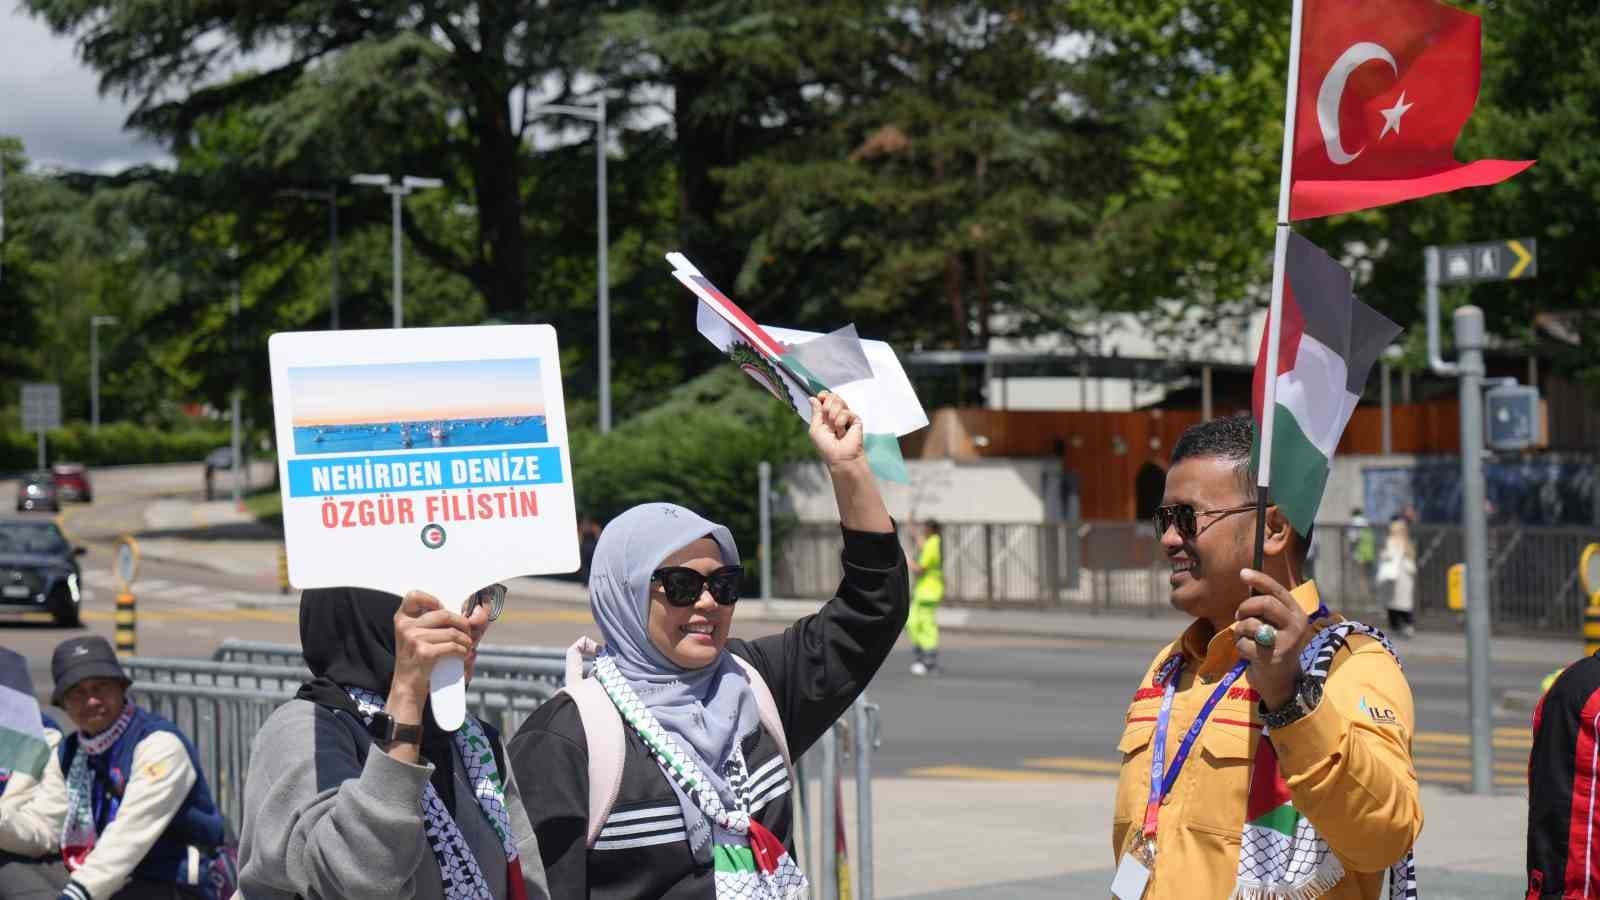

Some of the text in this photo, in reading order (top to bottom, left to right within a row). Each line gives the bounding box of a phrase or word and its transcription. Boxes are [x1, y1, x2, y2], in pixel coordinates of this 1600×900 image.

[311, 452, 541, 492] NEHİRDEN DENİZE
[321, 487, 538, 529] ÖZGÜR FİLİSTİN
